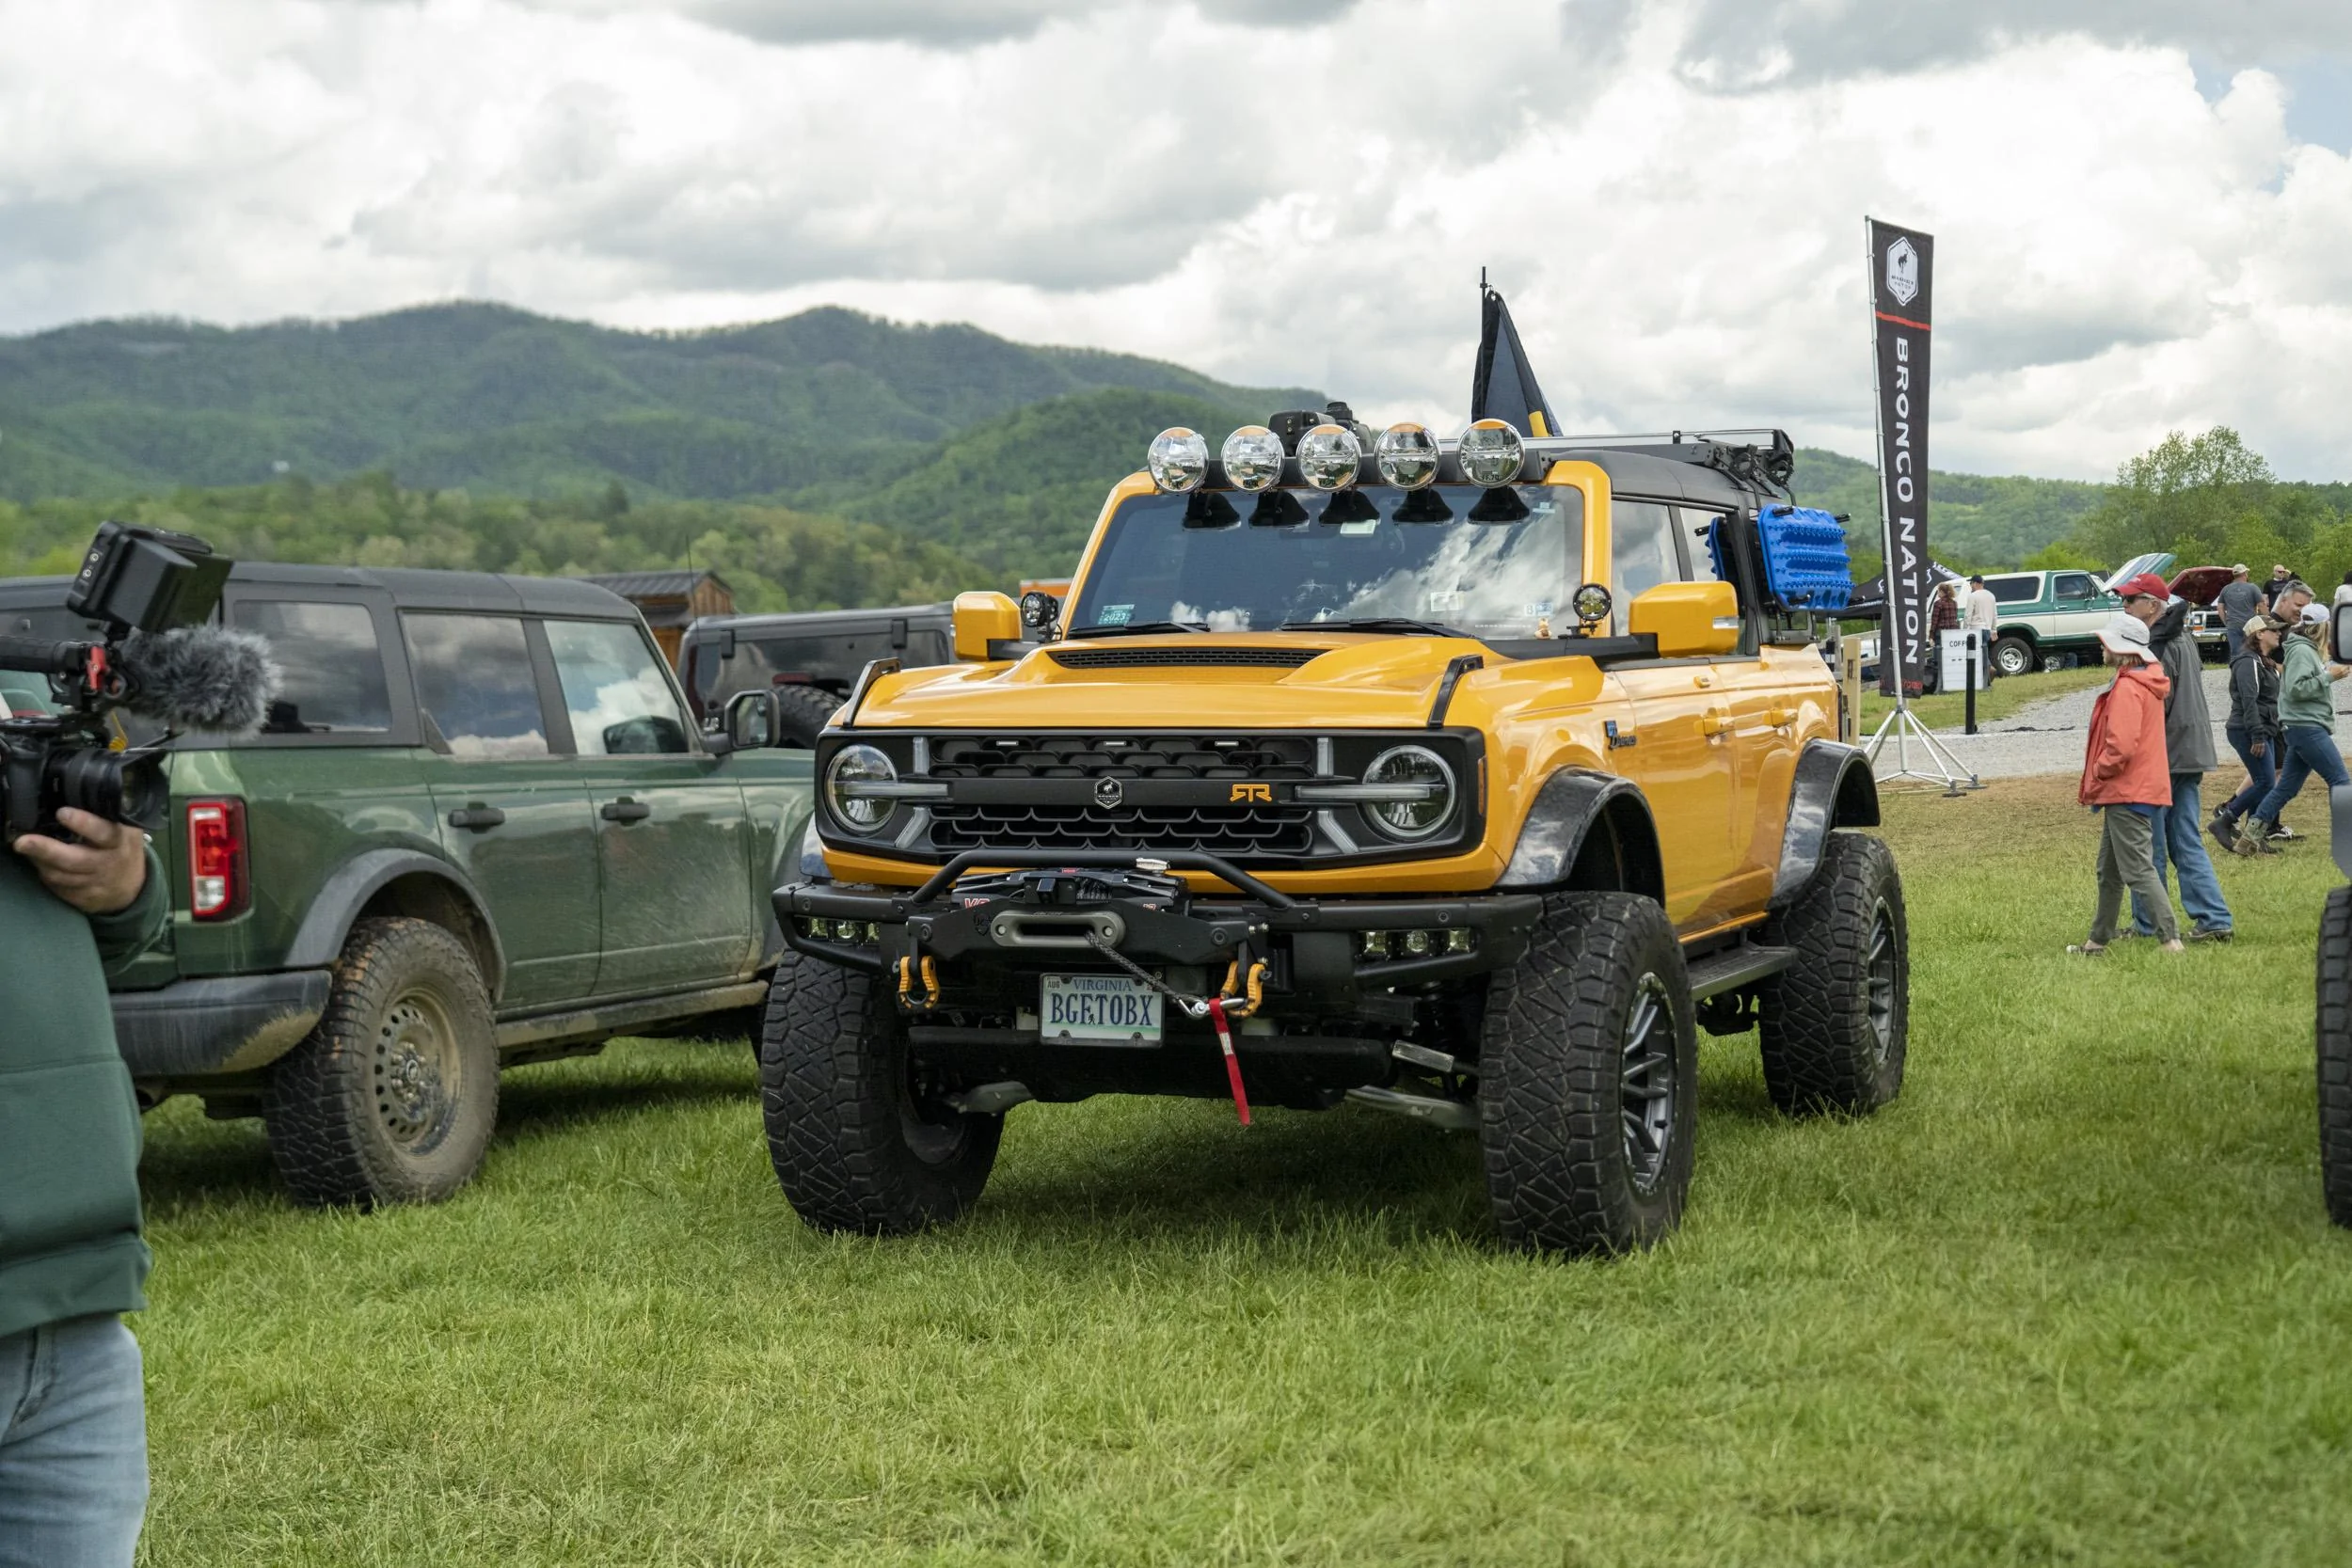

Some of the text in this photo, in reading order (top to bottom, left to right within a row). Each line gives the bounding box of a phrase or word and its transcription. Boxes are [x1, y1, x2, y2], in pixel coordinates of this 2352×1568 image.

[1896, 337, 1914, 503] BRONCO
[1899, 517, 1919, 664] NATION
[1230, 783, 1273, 803] RTR
[1073, 978, 1133, 991] VIRGINIA
